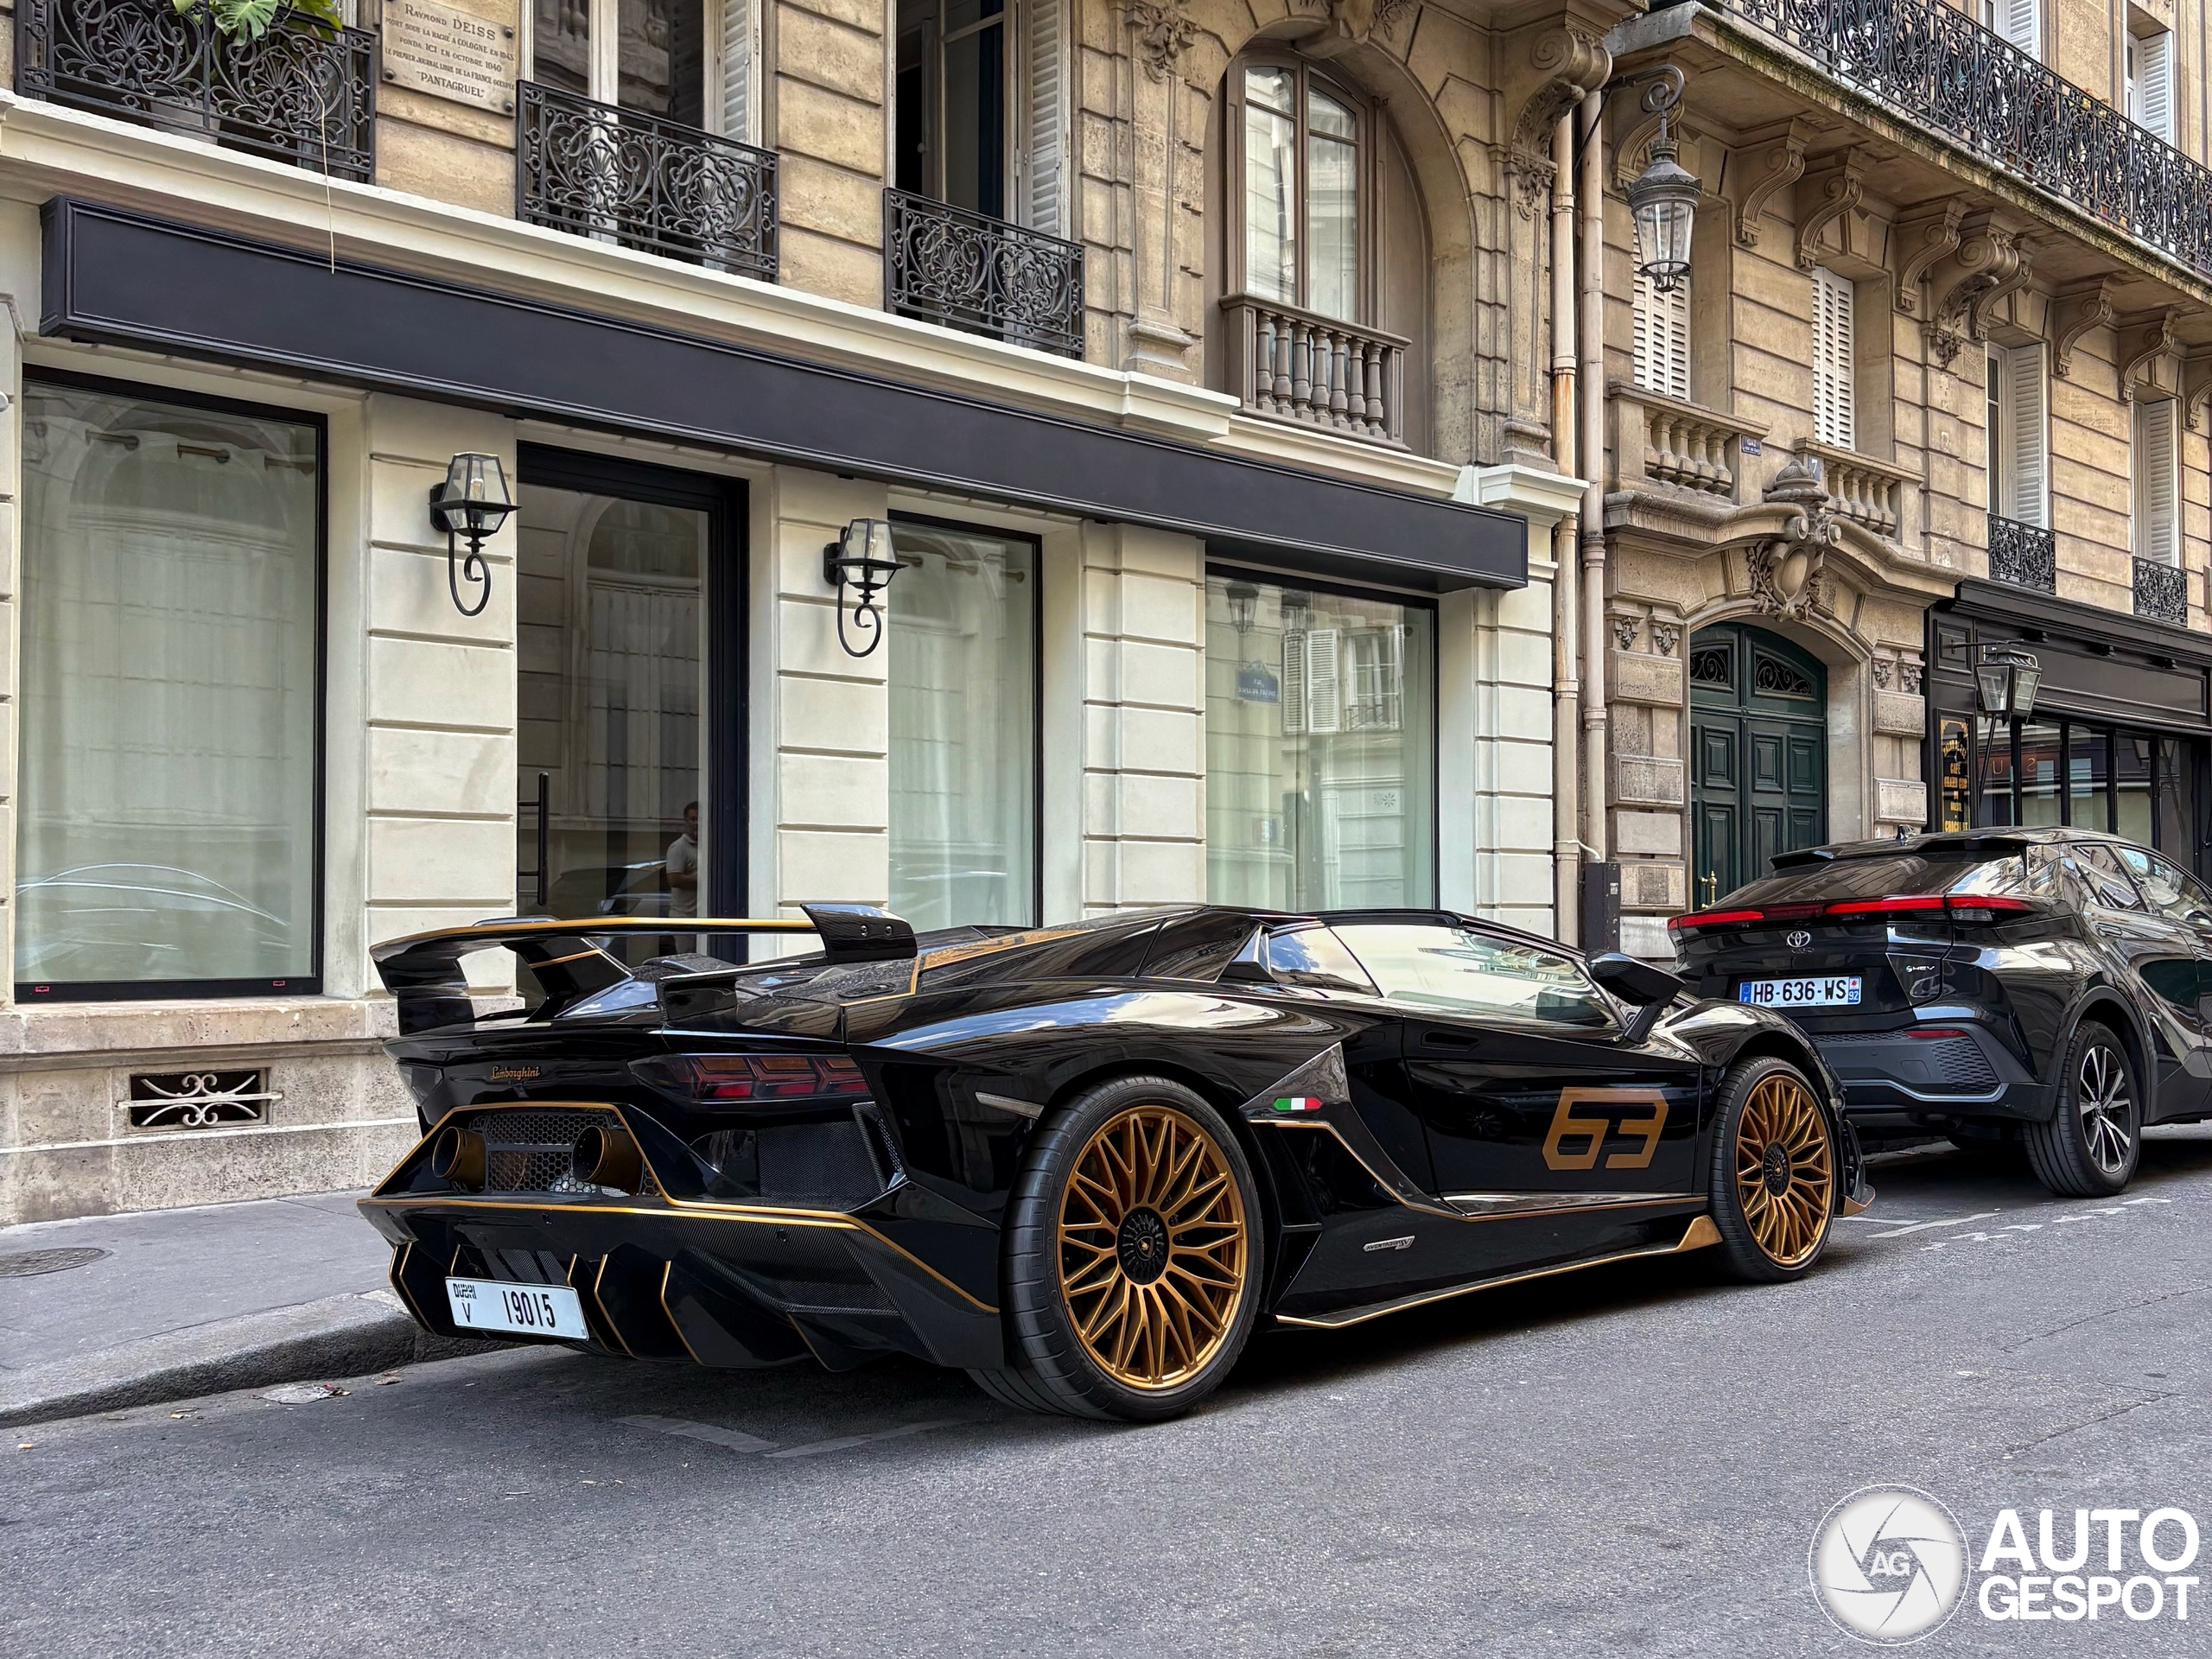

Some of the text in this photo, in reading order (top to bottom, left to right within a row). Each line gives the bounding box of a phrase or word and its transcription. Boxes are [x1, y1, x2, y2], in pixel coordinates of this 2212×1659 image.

[385, 17, 403, 28] MORT
[405, 23, 421, 34] SOUS
[423, 29, 431, 37] LA
[457, 38, 488, 54] COLOGNE
[490, 48, 499, 57] EN
[405, 3, 496, 41] RAYMOND DEISS
[392, 49, 416, 62] PREMIER
[416, 56, 440, 69] JOURNAL
[439, 62, 454, 73] LIBRE
[454, 67, 463, 76] DE
[463, 69, 471, 78] LA
[471, 71, 493, 85] FRANCE
[399, 36, 502, 73] FONDA ICI EN OCTOBRE 1940
[1753, 979, 1847, 1003] HB-636-WS
[1848, 990, 1859, 1001] 92
[490, 1065, 541, 1080] Lamborghini
[1541, 1086, 1669, 1171] 63
[461, 1302, 471, 1323] V
[502, 1290, 556, 1328] 19015
